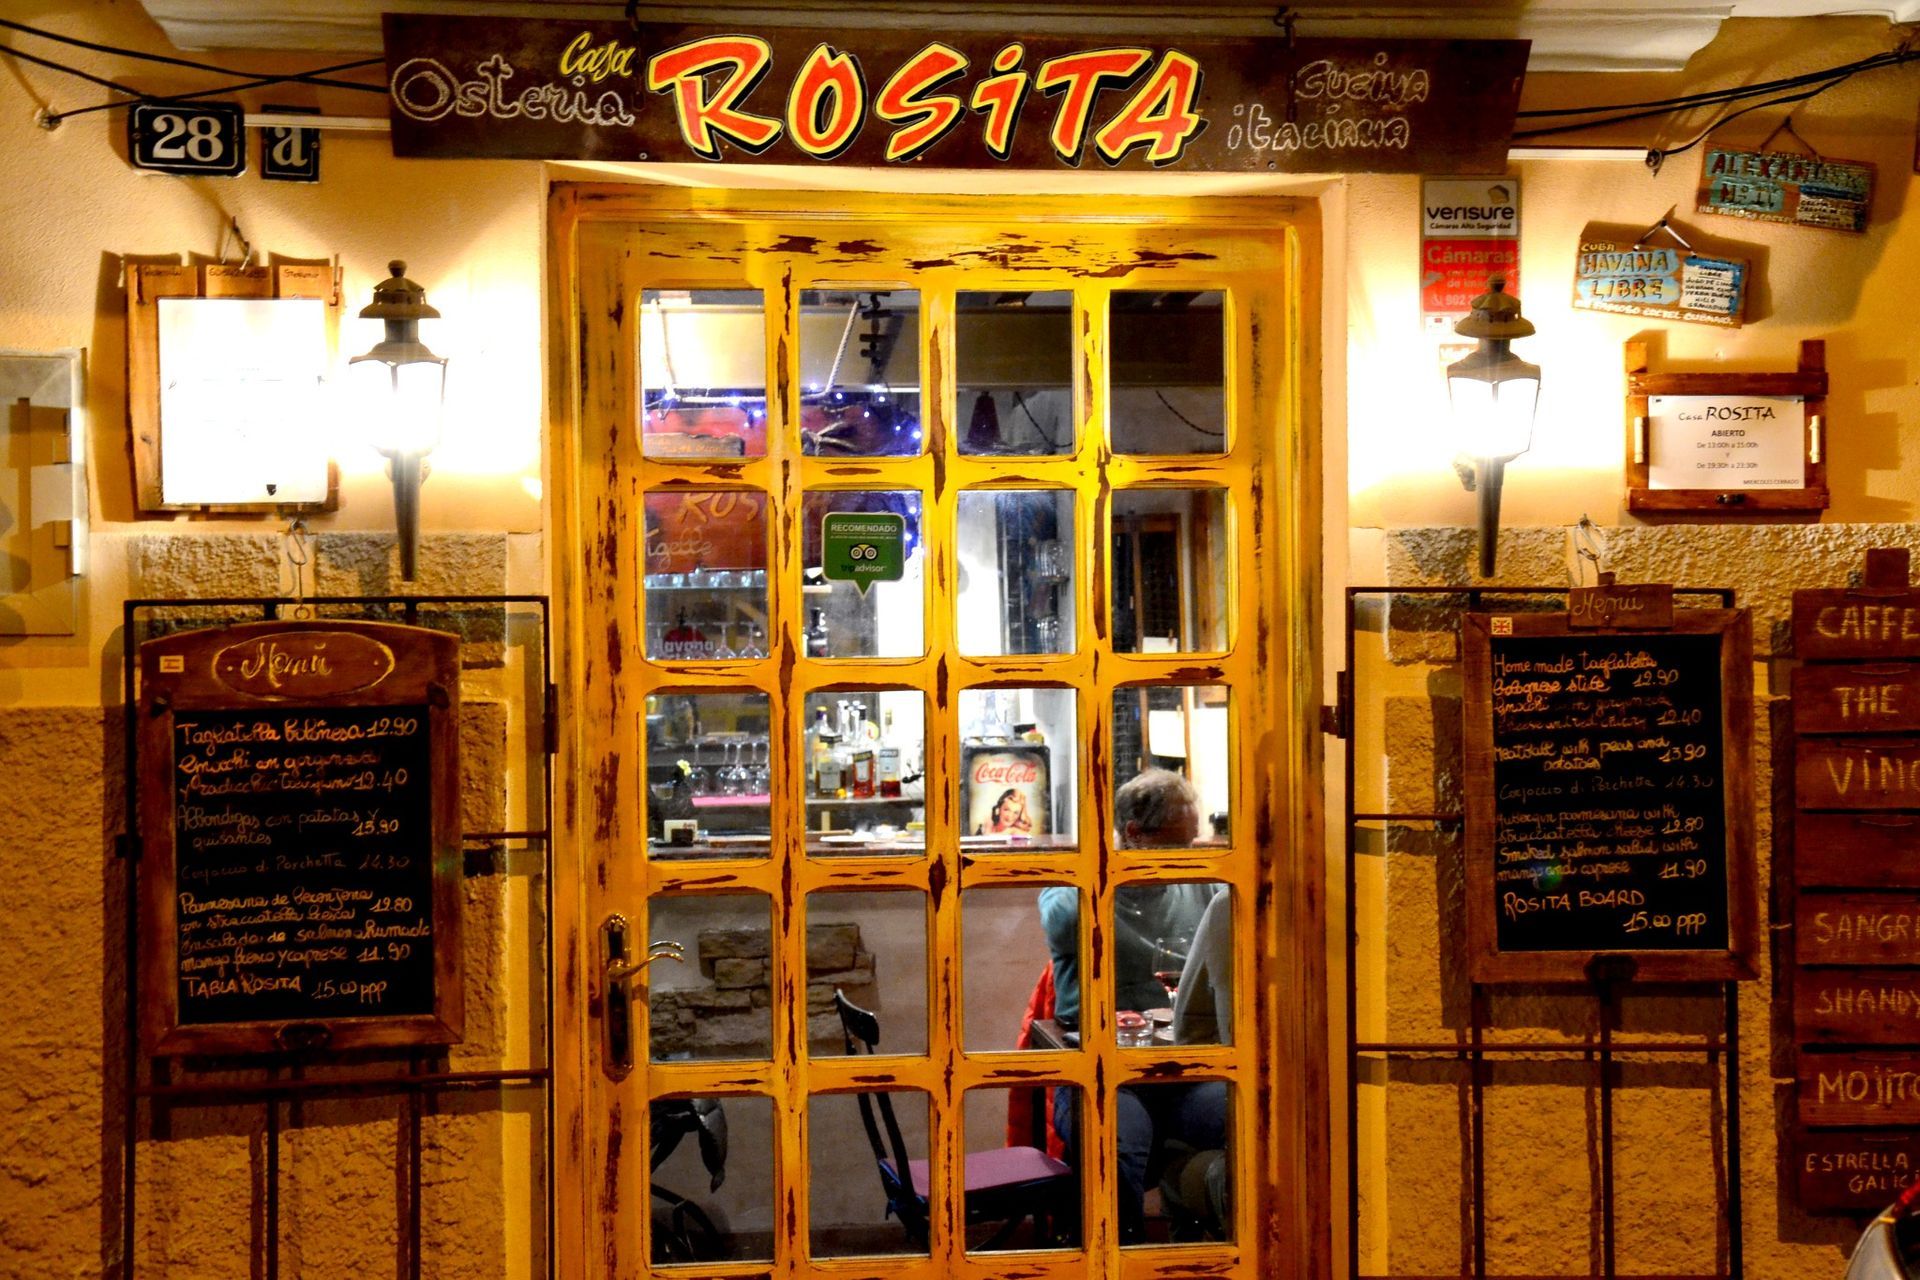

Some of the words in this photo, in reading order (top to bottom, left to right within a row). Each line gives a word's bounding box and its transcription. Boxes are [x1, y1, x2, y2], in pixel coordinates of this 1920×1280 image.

[560, 30, 635, 82] Casa
[390, 54, 636, 127] Osteria
[152, 113, 224, 162] 28
[1427, 206, 1515, 220] verisure
[1428, 245, 1514, 264] Cámaras
[1581, 242, 1615, 252] CUBA
[1584, 251, 1669, 274] HAVANA
[1592, 278, 1664, 300] LIBRE
[1678, 412, 1703, 421] Casa
[1705, 406, 1776, 421] ROSITA
[1711, 429, 1745, 437] ABIERTO
[830, 523, 897, 533] RECOMENDADO
[1815, 604, 1920, 640] CAFFE
[1633, 669, 1679, 687] 12.90
[1832, 683, 1904, 719] THE
[366, 717, 418, 738] 12.90
[1658, 859, 1707, 880] 11.90
[271, 893, 290, 907] de
[1579, 889, 1646, 908] BOARD
[1622, 911, 1672, 933] 15.00
[181, 976, 239, 998] TABLA
[241, 972, 301, 995] ROSITA
[1805, 1152, 1909, 1173] ESTRELLA
